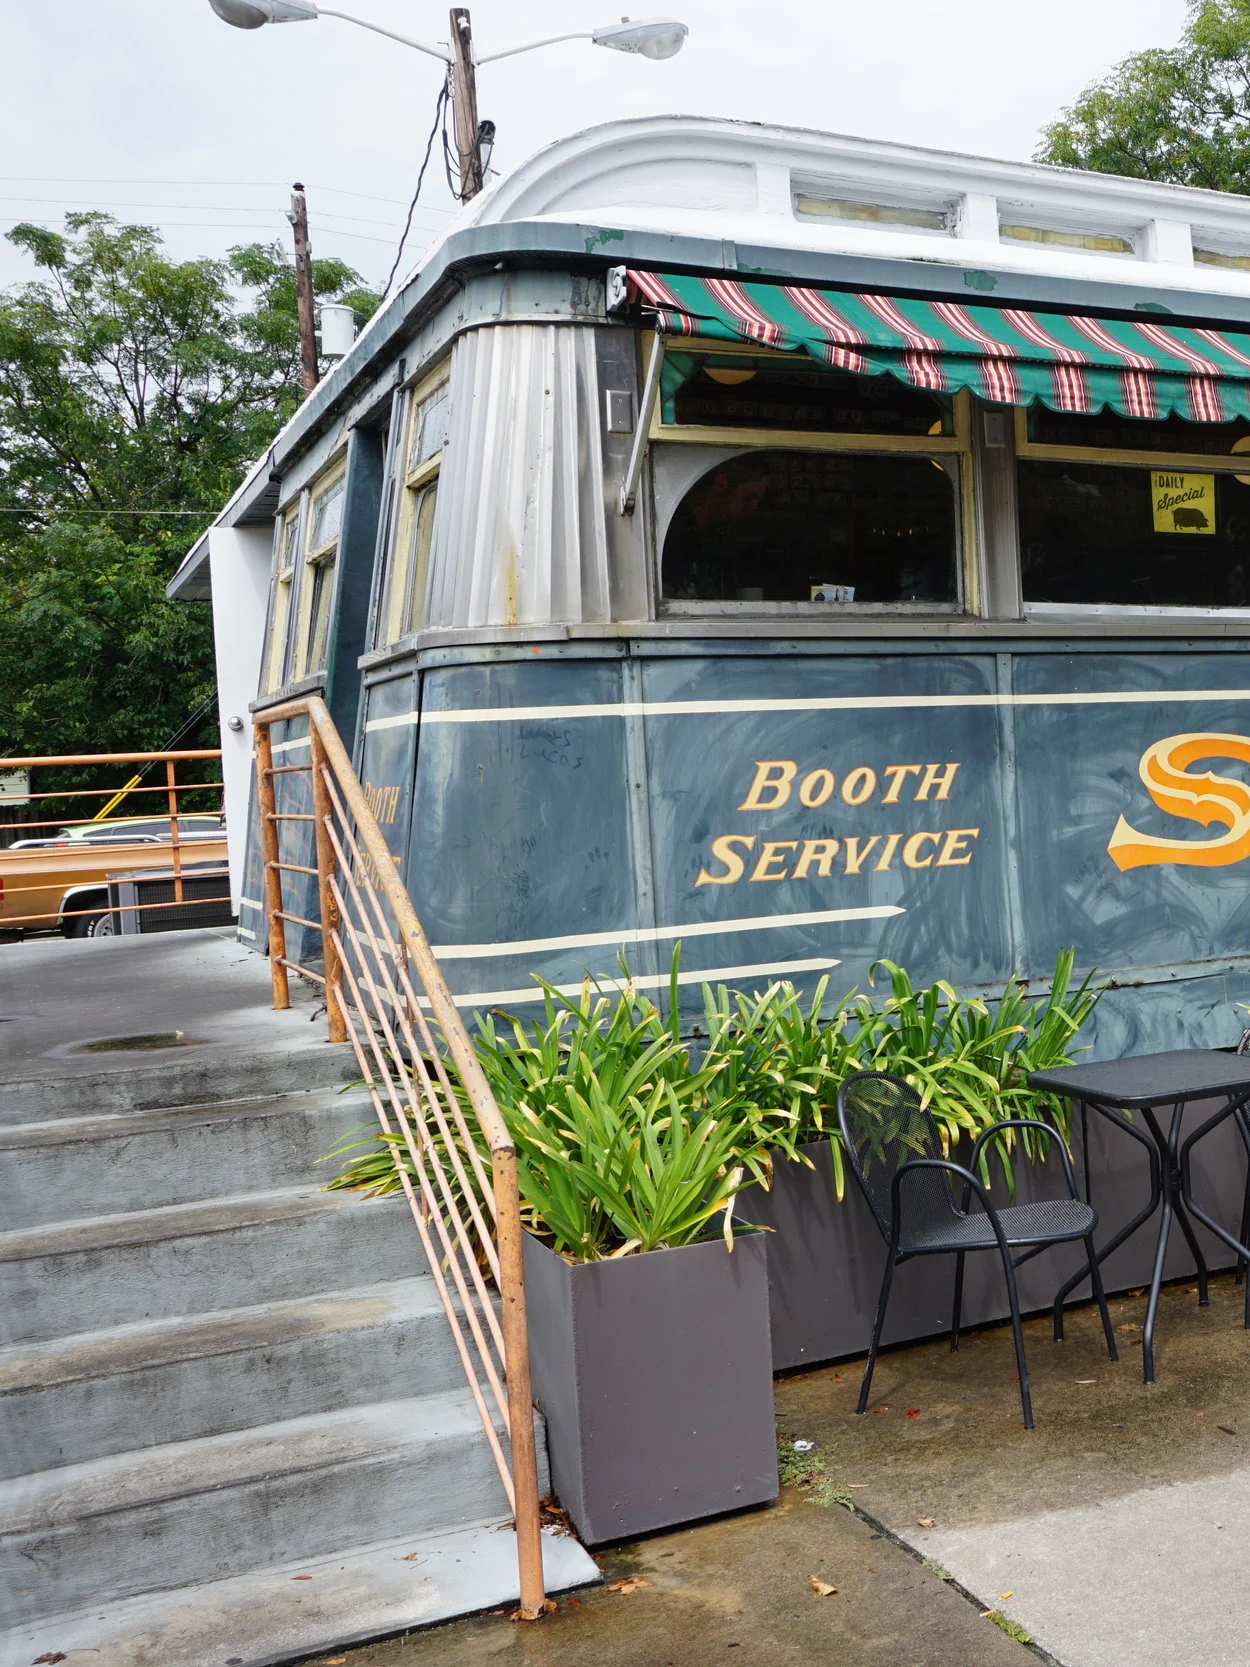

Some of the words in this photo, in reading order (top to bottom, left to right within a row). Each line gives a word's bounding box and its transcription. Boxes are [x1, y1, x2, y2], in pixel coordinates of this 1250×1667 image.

[1157, 486, 1205, 511] Special
[1158, 475, 1184, 488] DAILY
[737, 760, 961, 811] BOOTH
[694, 827, 980, 888] SERVICE
